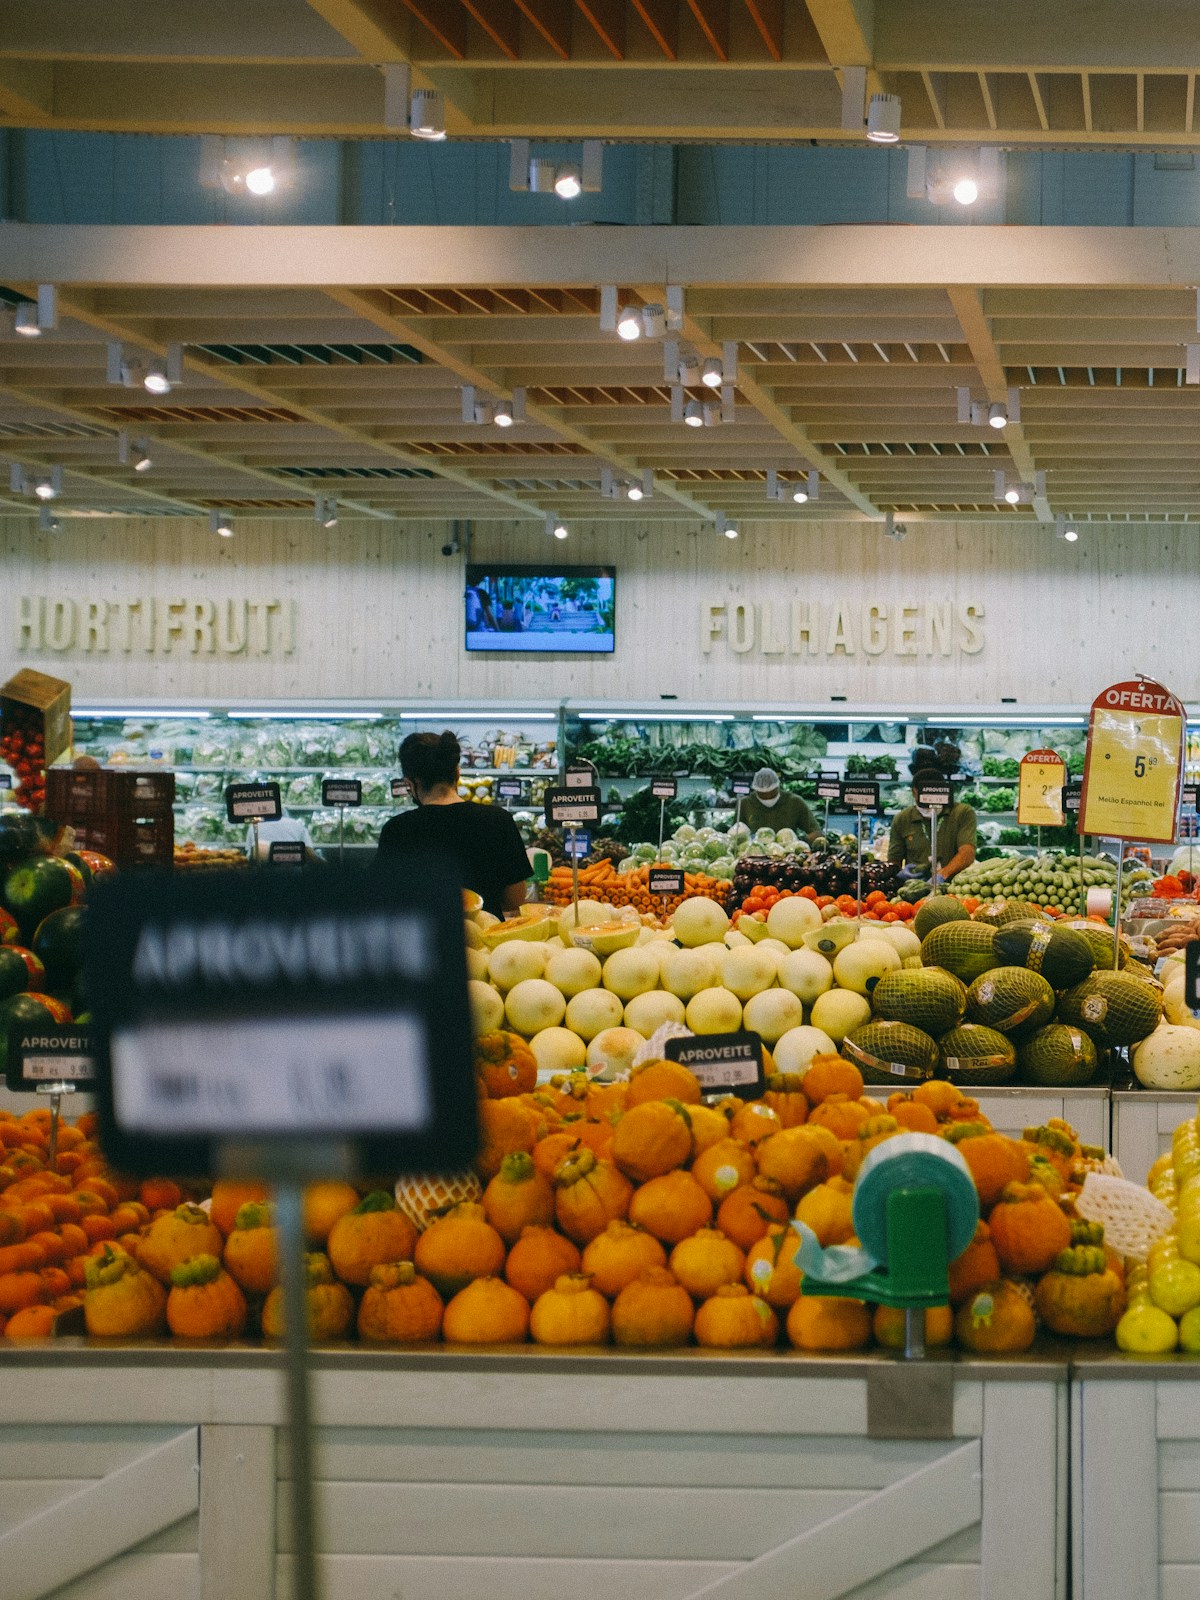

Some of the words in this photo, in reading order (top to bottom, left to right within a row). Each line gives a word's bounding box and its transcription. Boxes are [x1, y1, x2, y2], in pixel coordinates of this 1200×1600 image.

[16, 597, 296, 653] HORTIFRUTI
[701, 601, 985, 656] FOLHAGENS
[1106, 690, 1176, 711] OFERTA
[1027, 755, 1061, 763] OFERTA
[232, 790, 274, 799] APROVEITE
[552, 795, 595, 803] APROVEITE
[21, 1037, 89, 1048] APROVEIT
[679, 1045, 752, 1062] APROVEITE
